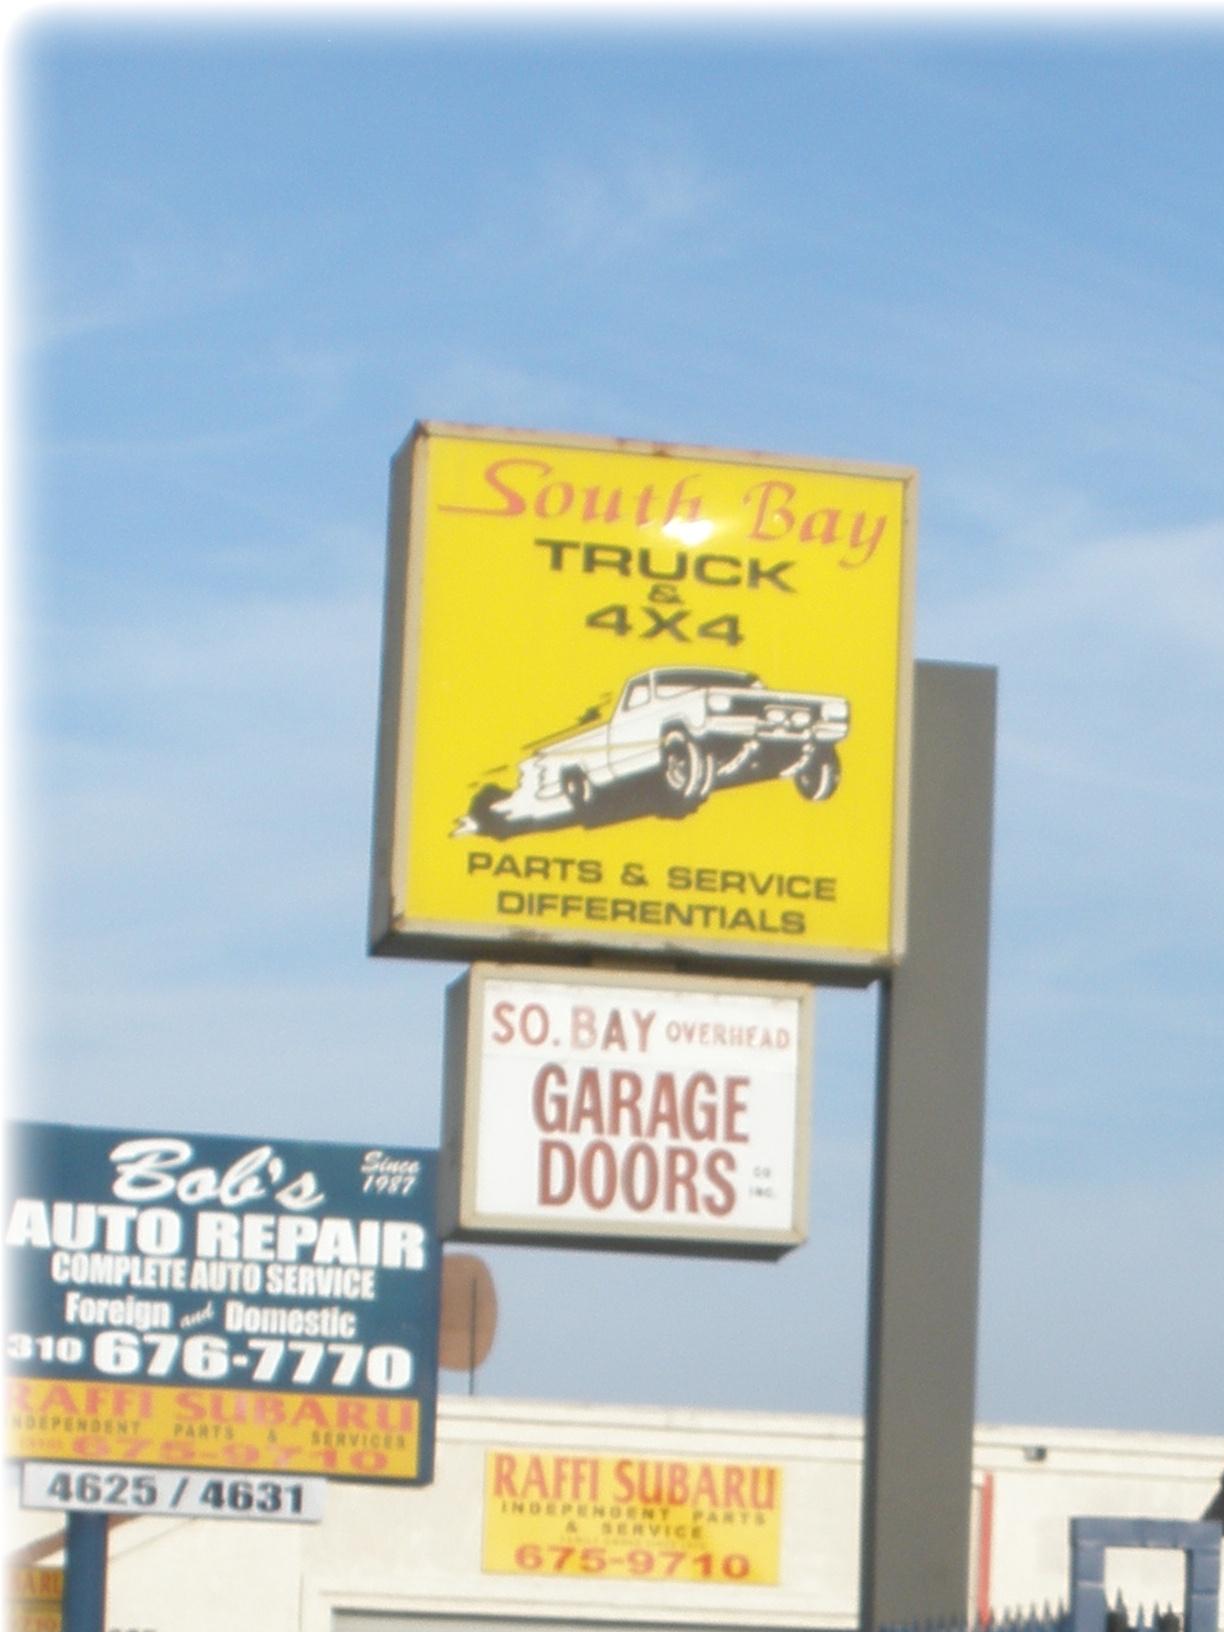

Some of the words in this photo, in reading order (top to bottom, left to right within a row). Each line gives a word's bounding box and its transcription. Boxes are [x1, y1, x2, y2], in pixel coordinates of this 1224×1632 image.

[437, 457, 702, 527] South
[742, 480, 889, 569] Bay
[534, 538, 798, 593] TRUCK
[647, 583, 684, 605] &
[585, 604, 745, 648] 4X4
[467, 851, 603, 884] PARTS
[619, 863, 649, 887] &
[667, 866, 838, 901] SERVICE
[497, 890, 806, 935] DIFFERENTIALS
[491, 1001, 561, 1048] SO.
[570, 1006, 657, 1053] BAY
[665, 1020, 792, 1051] OVERHEAD
[533, 1062, 751, 1144] GARAGE
[109, 1138, 326, 1210] Bob's
[360, 1150, 421, 1176] Since
[361, 1175, 416, 1197] 1987
[537, 1139, 737, 1217] DOORS
[5, 1198, 184, 1257] AUTO
[196, 1211, 428, 1271] REPAIR
[51, 1250, 187, 1291] COMPLETE
[190, 1259, 262, 1294] AUTO
[265, 1264, 376, 1300] SERVICE
[65, 1290, 172, 1331] Foreign
[180, 1301, 216, 1330] and
[224, 1300, 357, 1339] Domestic
[8, 1332, 83, 1364] 310
[93, 1331, 414, 1391] 676-7770
[13, 1415, 141, 1436] NDEPENDENT
[174, 1423, 235, 1441] PARTS
[267, 1429, 278, 1443] &
[311, 1430, 407, 1449] SERVICES
[174, 1391, 416, 1432] SUBARU
[73, 1435, 389, 1474] 675-9710
[46, 1471, 159, 1508] 4625
[170, 1477, 190, 1509] /
[200, 1479, 305, 1515] 4631
[493, 1452, 600, 1501] RAFFI
[613, 1458, 776, 1511] SUBARU
[501, 1501, 672, 1521] INDEPENDENT
[692, 1509, 767, 1527] PARTS
[601, 1521, 703, 1540] SERVICE
[514, 1543, 751, 1580] 675-9710
